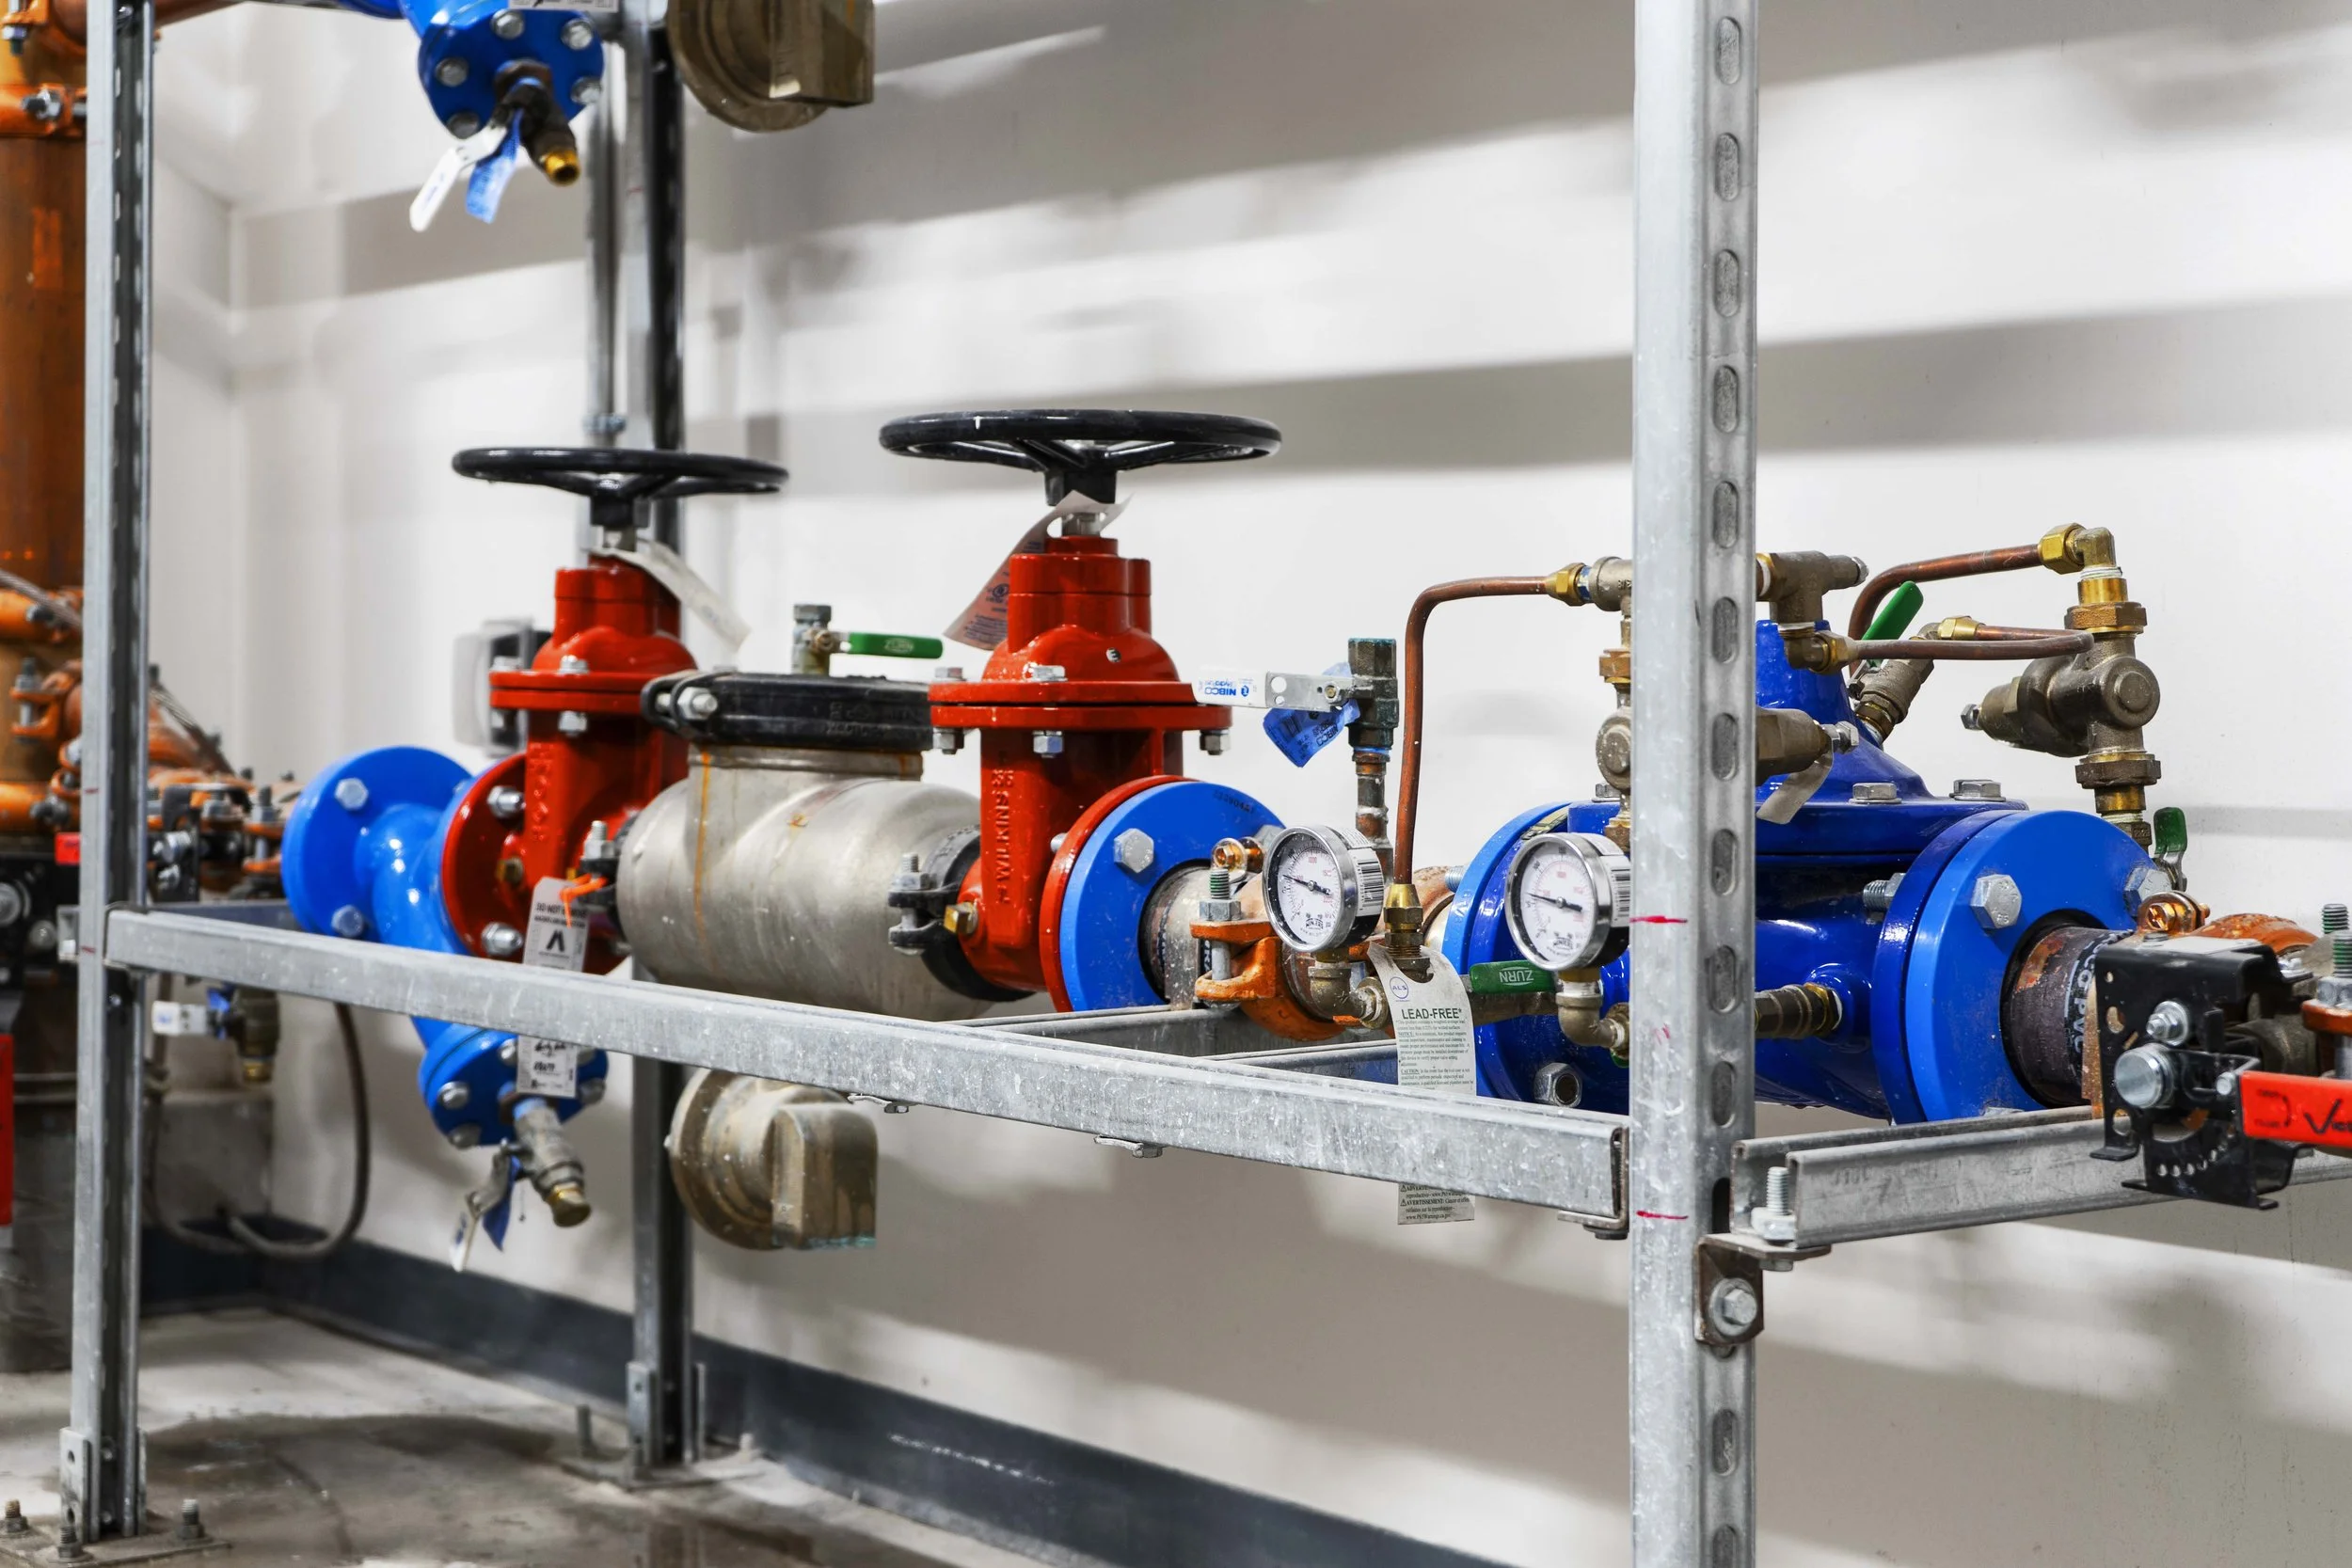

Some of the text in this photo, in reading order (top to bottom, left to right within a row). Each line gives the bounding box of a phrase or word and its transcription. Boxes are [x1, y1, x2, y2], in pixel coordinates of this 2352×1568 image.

[1204, 687, 1237, 696] NIBCO
[993, 790, 1010, 881] WILKINS
[1500, 969, 1534, 983] ZURN
